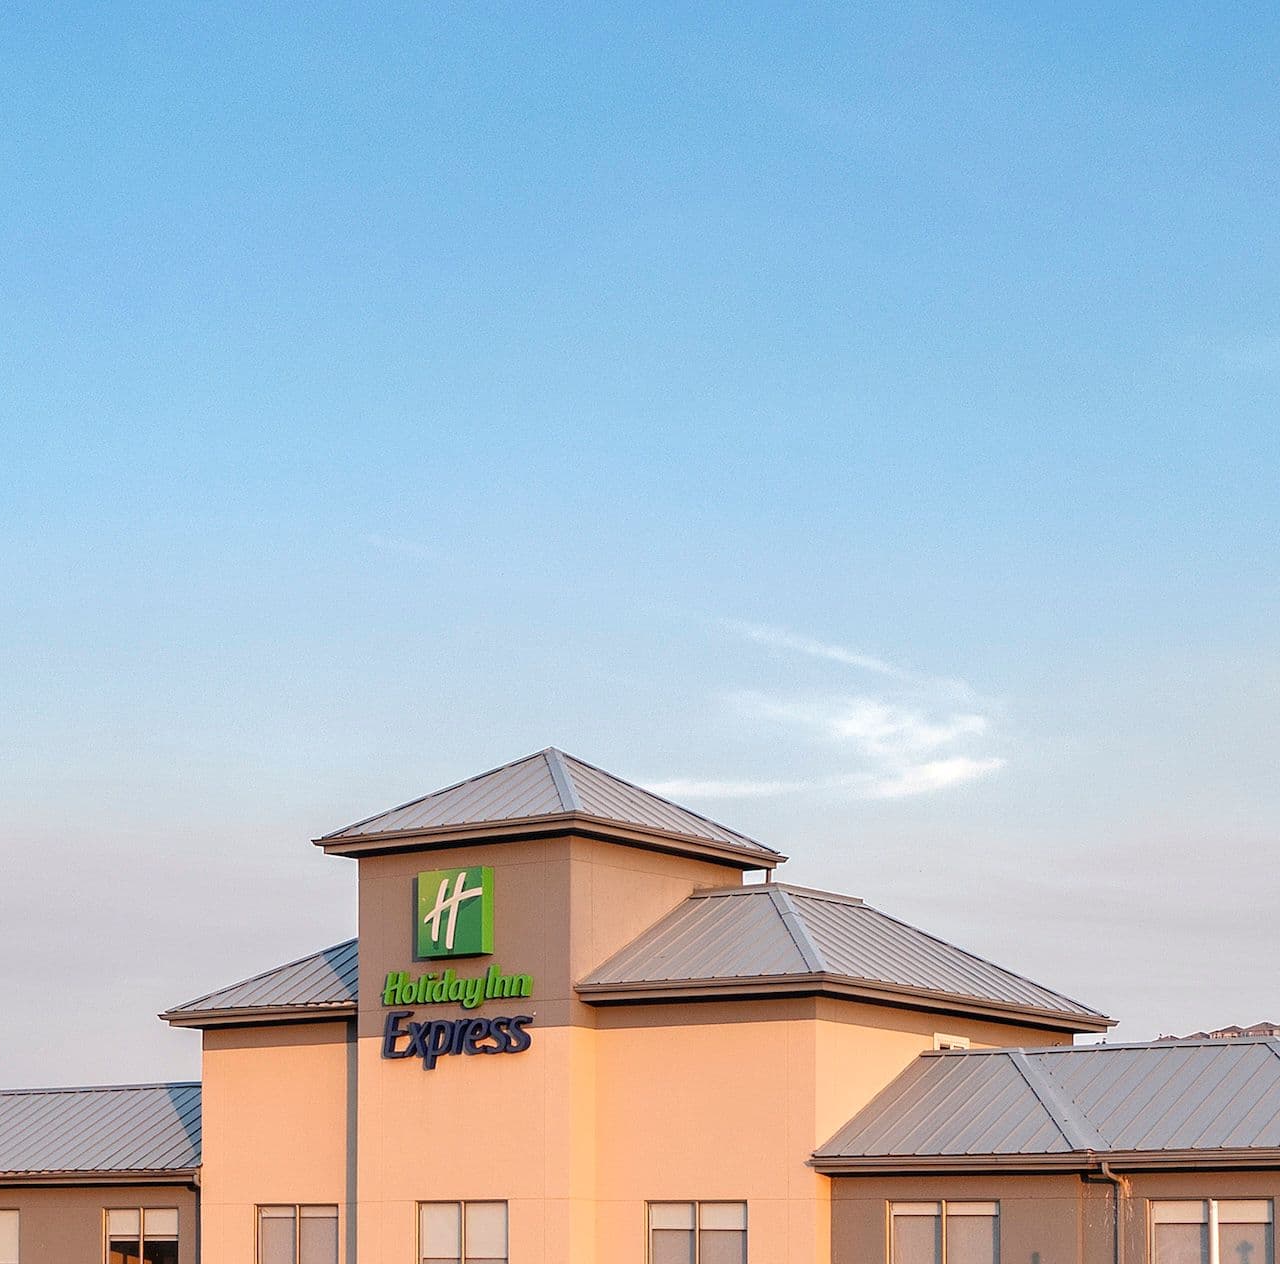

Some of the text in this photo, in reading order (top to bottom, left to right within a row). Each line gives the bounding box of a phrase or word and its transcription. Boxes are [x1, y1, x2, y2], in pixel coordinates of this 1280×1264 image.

[382, 964, 534, 1009] Holiday Inn
[382, 1010, 534, 1071] Express
